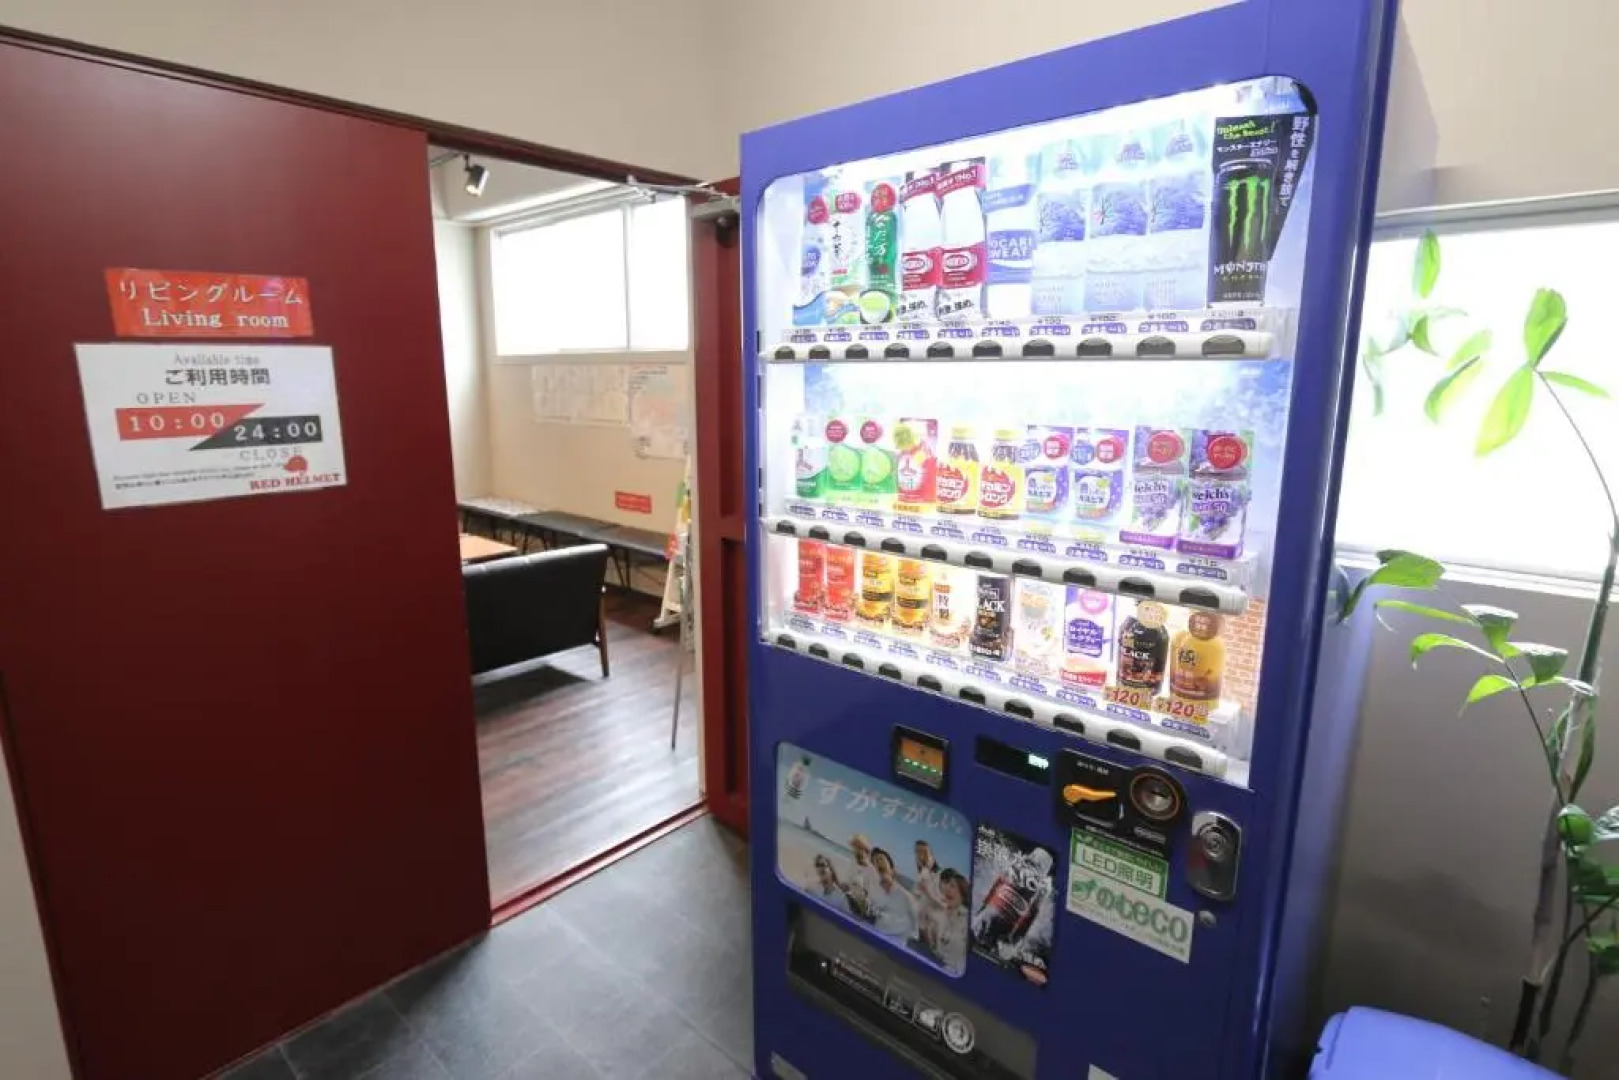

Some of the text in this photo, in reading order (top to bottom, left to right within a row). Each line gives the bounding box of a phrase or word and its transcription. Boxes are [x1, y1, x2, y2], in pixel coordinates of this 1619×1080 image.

[119, 279, 303, 305] リビングルーム
[143, 307, 290, 329] Living room
[165, 368, 270, 387] ご利用時間
[137, 391, 196, 405] OPEN
[129, 412, 225, 433] 10:00
[233, 422, 318, 441] 24:00
[239, 446, 303, 462] CLOSE
[249, 476, 281, 491] RED
[285, 472, 341, 487] HELMET
